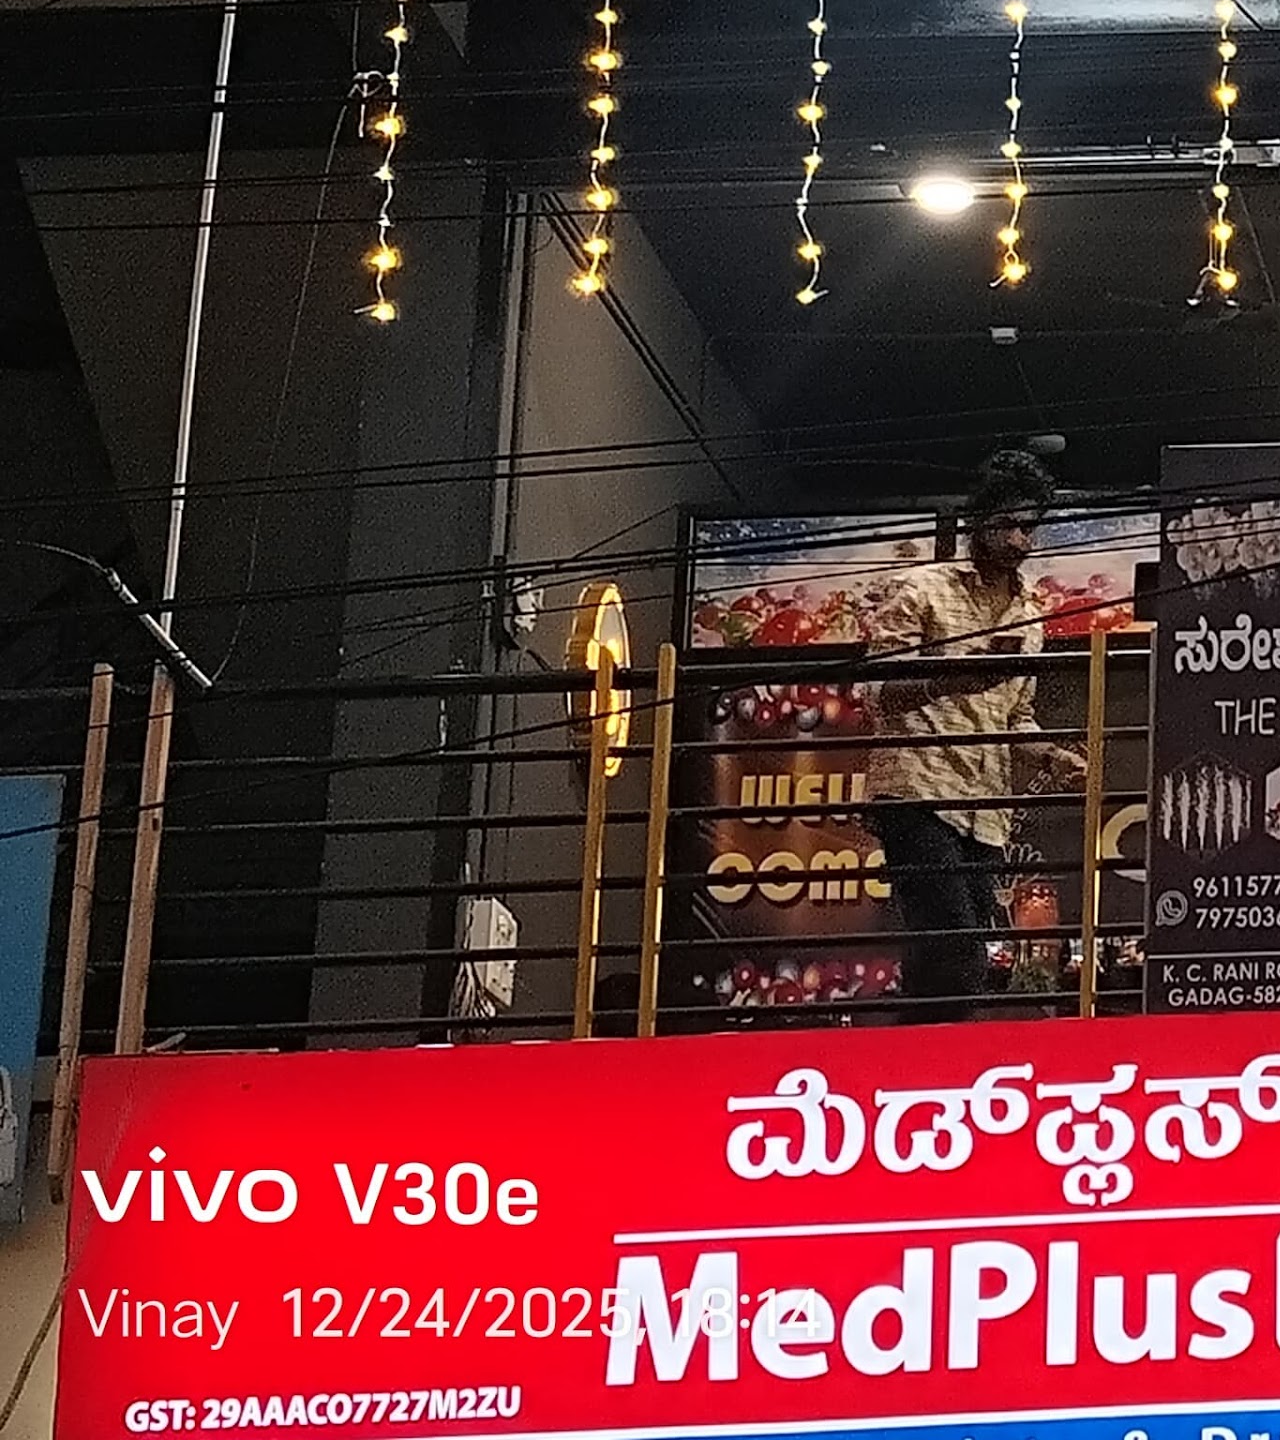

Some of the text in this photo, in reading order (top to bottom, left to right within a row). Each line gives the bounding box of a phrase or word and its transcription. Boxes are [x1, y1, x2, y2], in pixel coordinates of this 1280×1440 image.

[1214, 698, 1277, 735] THE
[1163, 964, 1180, 984] K.
[1186, 964, 1207, 982] C.
[1213, 961, 1259, 981] RANI
[606, 1240, 1254, 1387] MedPlus
[125, 1400, 196, 1432] GST:
